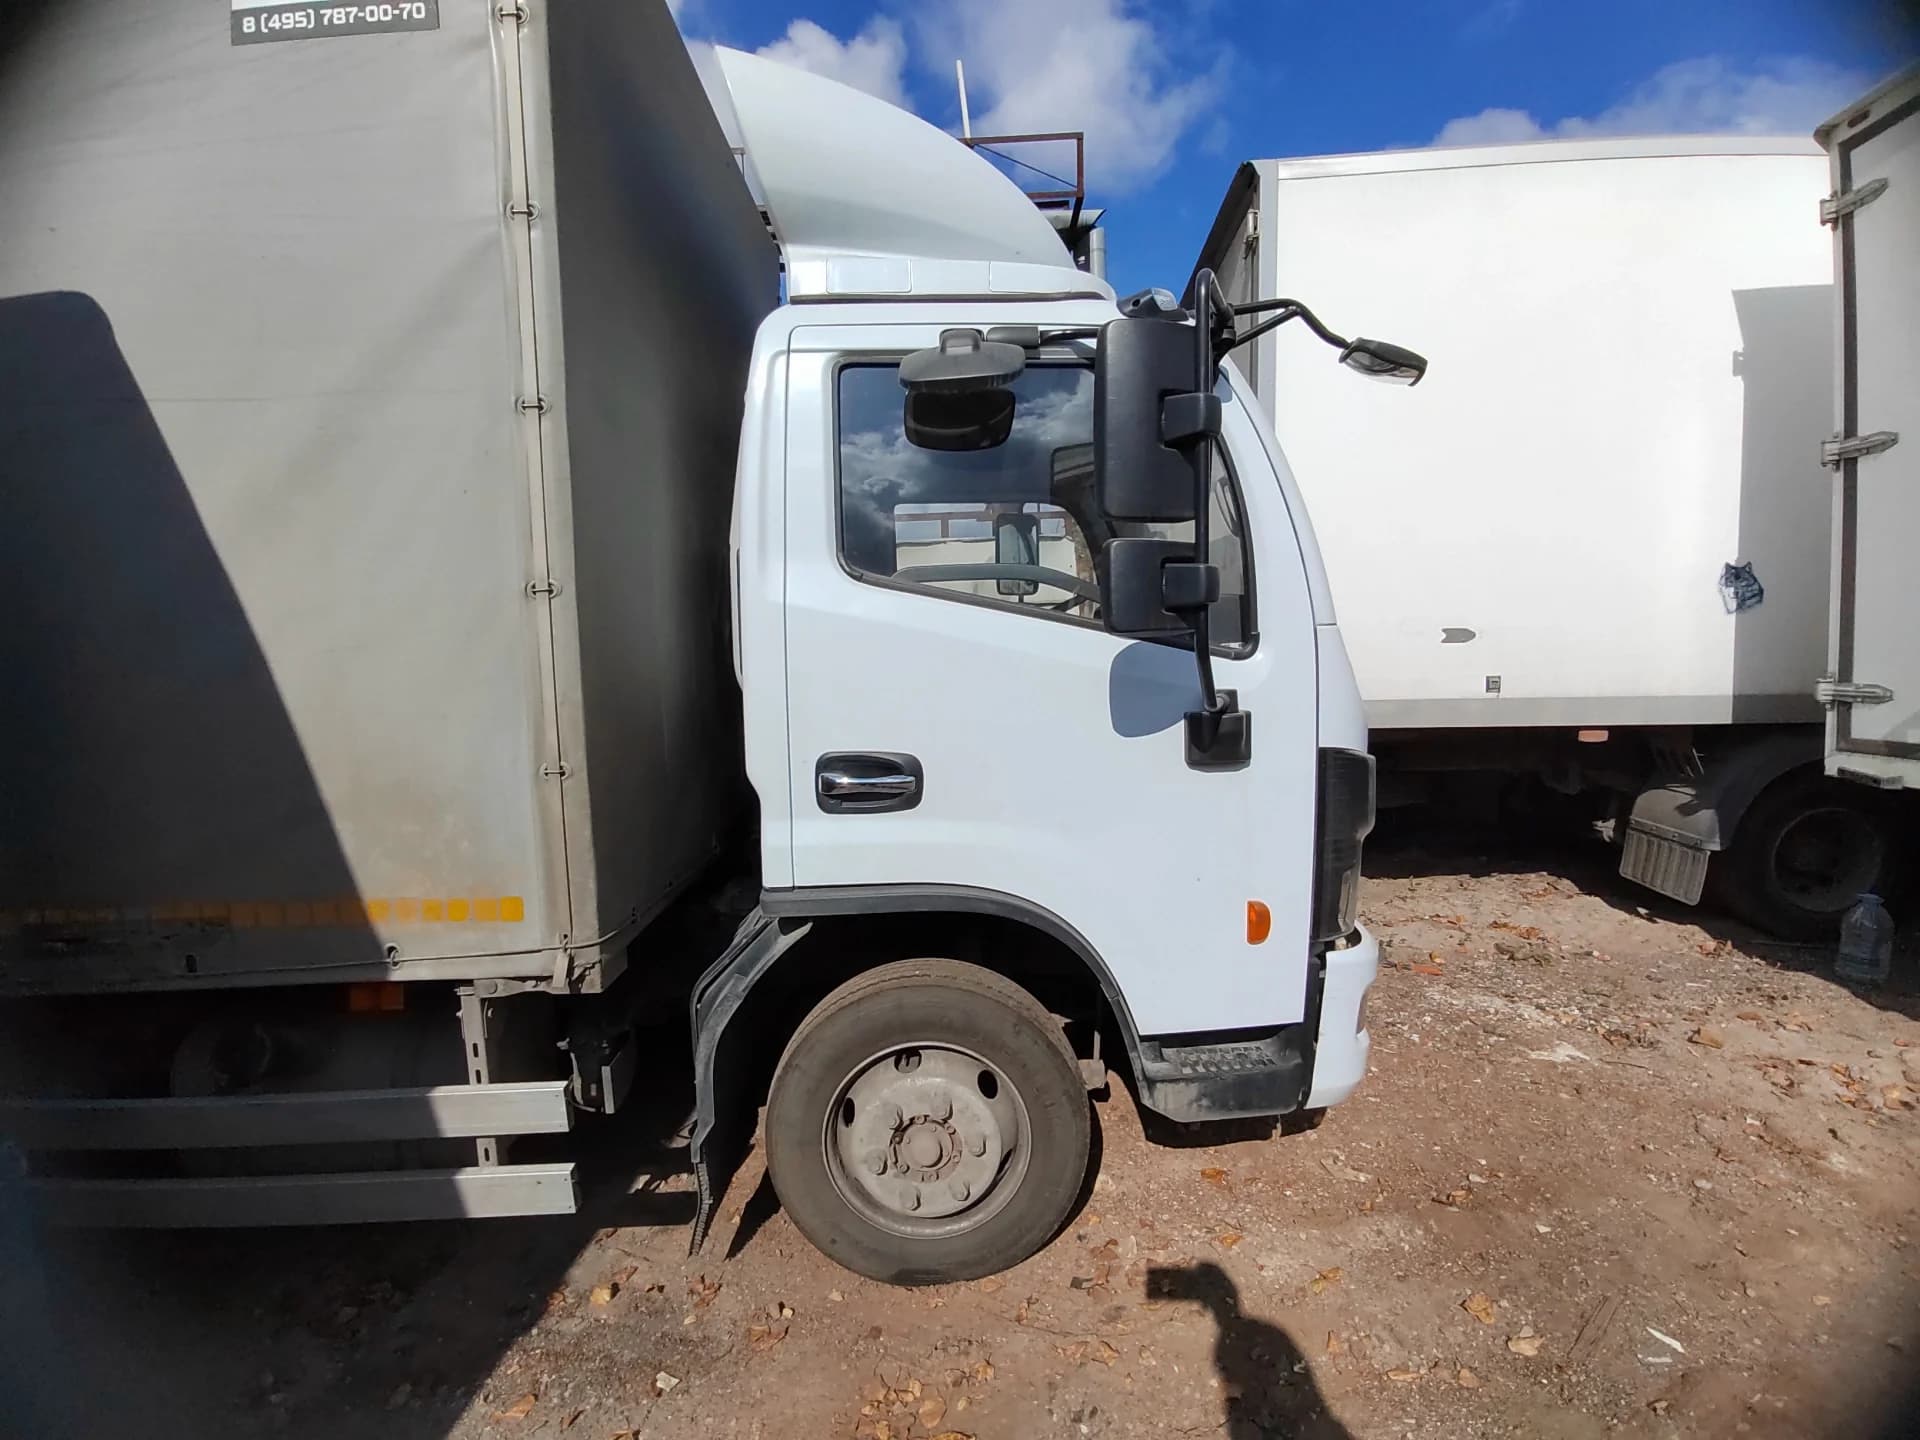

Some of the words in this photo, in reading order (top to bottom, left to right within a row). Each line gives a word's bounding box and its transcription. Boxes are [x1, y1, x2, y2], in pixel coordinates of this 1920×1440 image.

[242, 16, 256, 33] 8
[260, 9, 315, 33] (495)
[320, 2, 426, 25] 787-00-70
